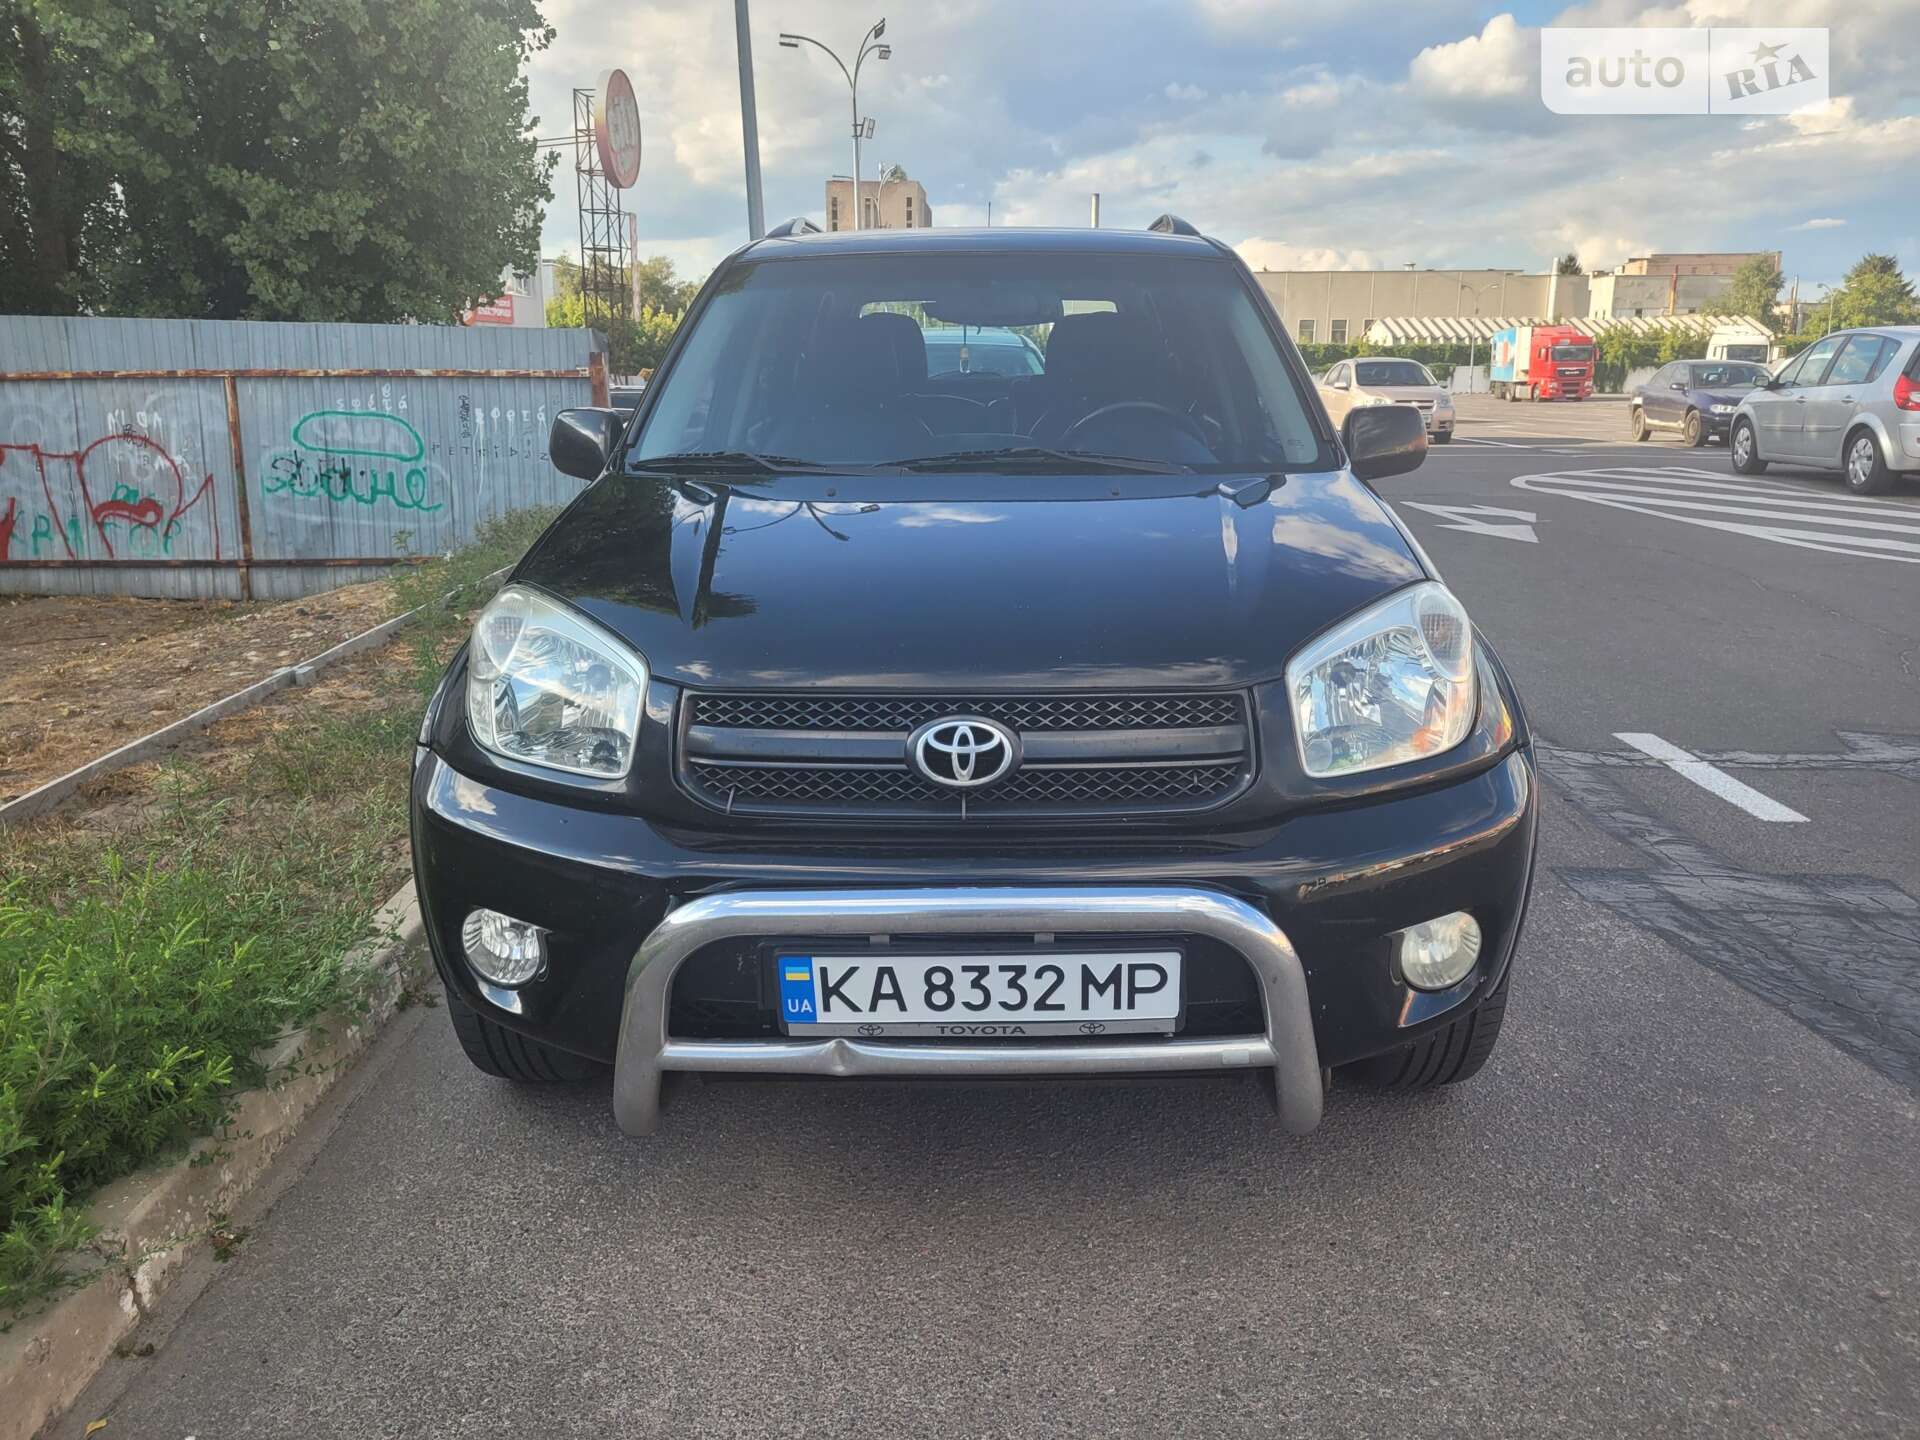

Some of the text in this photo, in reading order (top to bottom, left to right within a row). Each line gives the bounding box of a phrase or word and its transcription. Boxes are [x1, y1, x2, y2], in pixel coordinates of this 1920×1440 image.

[819, 963, 1169, 1013] KA 8332 MP
[788, 998, 813, 1014] UA
[935, 1024, 1027, 1036] TOYOTA
